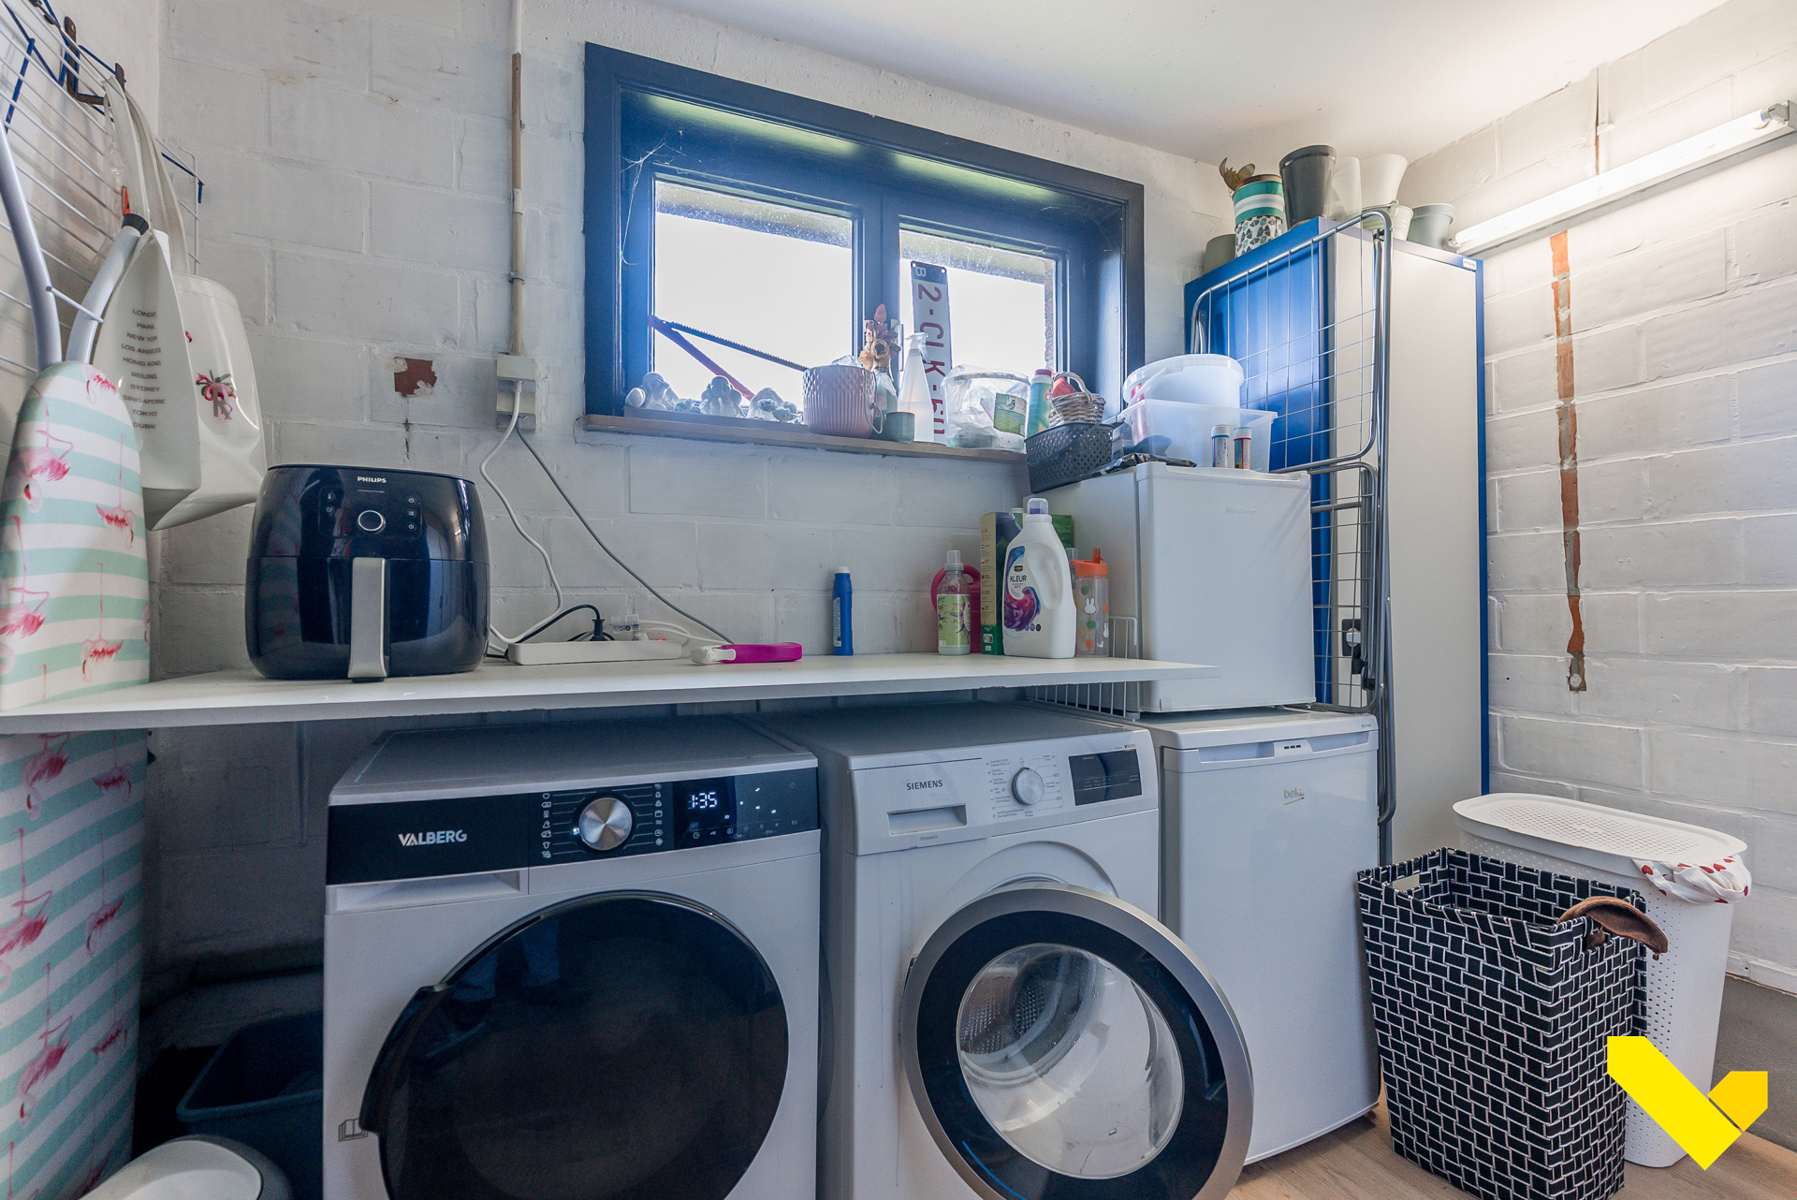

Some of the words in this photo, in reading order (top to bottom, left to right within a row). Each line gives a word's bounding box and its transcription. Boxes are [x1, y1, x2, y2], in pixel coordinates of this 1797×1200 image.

[915, 266, 926, 277] B
[126, 332, 145, 342] NEW
[121, 343, 136, 352] LOS
[122, 356, 146, 367] HONG
[129, 383, 160, 392] SYDNEY
[122, 394, 165, 405] SINGAPORE
[132, 409, 158, 417] TOKYO
[132, 422, 156, 430] DUBAI
[356, 476, 387, 484] PHILIPS
[1009, 574, 1027, 582] KLEUR
[906, 779, 944, 791] SIEMENS
[1283, 787, 1305, 799] beko
[691, 791, 718, 809] 1:35
[397, 829, 468, 847] VALBERG
